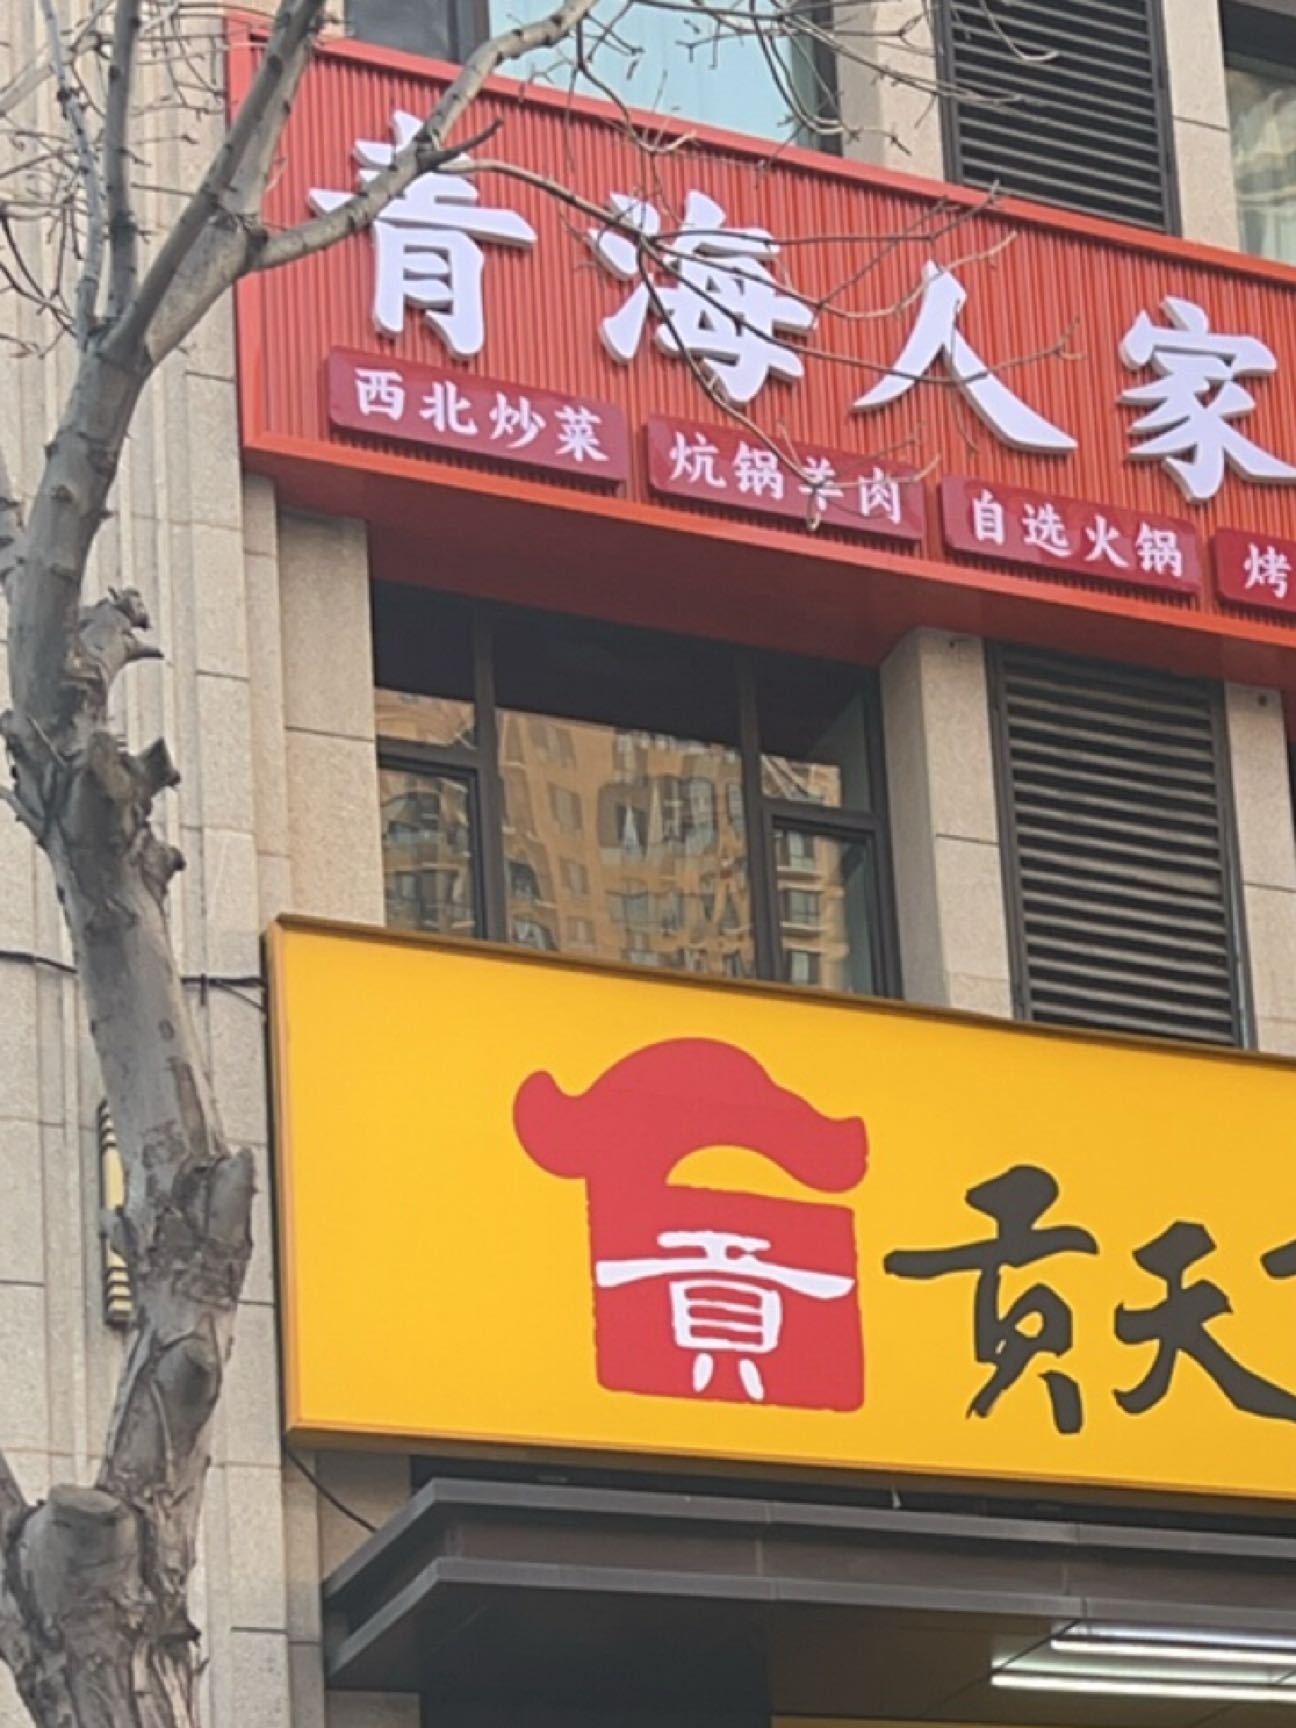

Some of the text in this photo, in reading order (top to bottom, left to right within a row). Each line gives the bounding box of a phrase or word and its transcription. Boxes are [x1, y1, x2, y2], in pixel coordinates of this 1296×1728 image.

[355, 370, 608, 464] 西北炒菜
[669, 432, 901, 525] 炕锅羊肉
[972, 489, 1183, 577] 自选火锅
